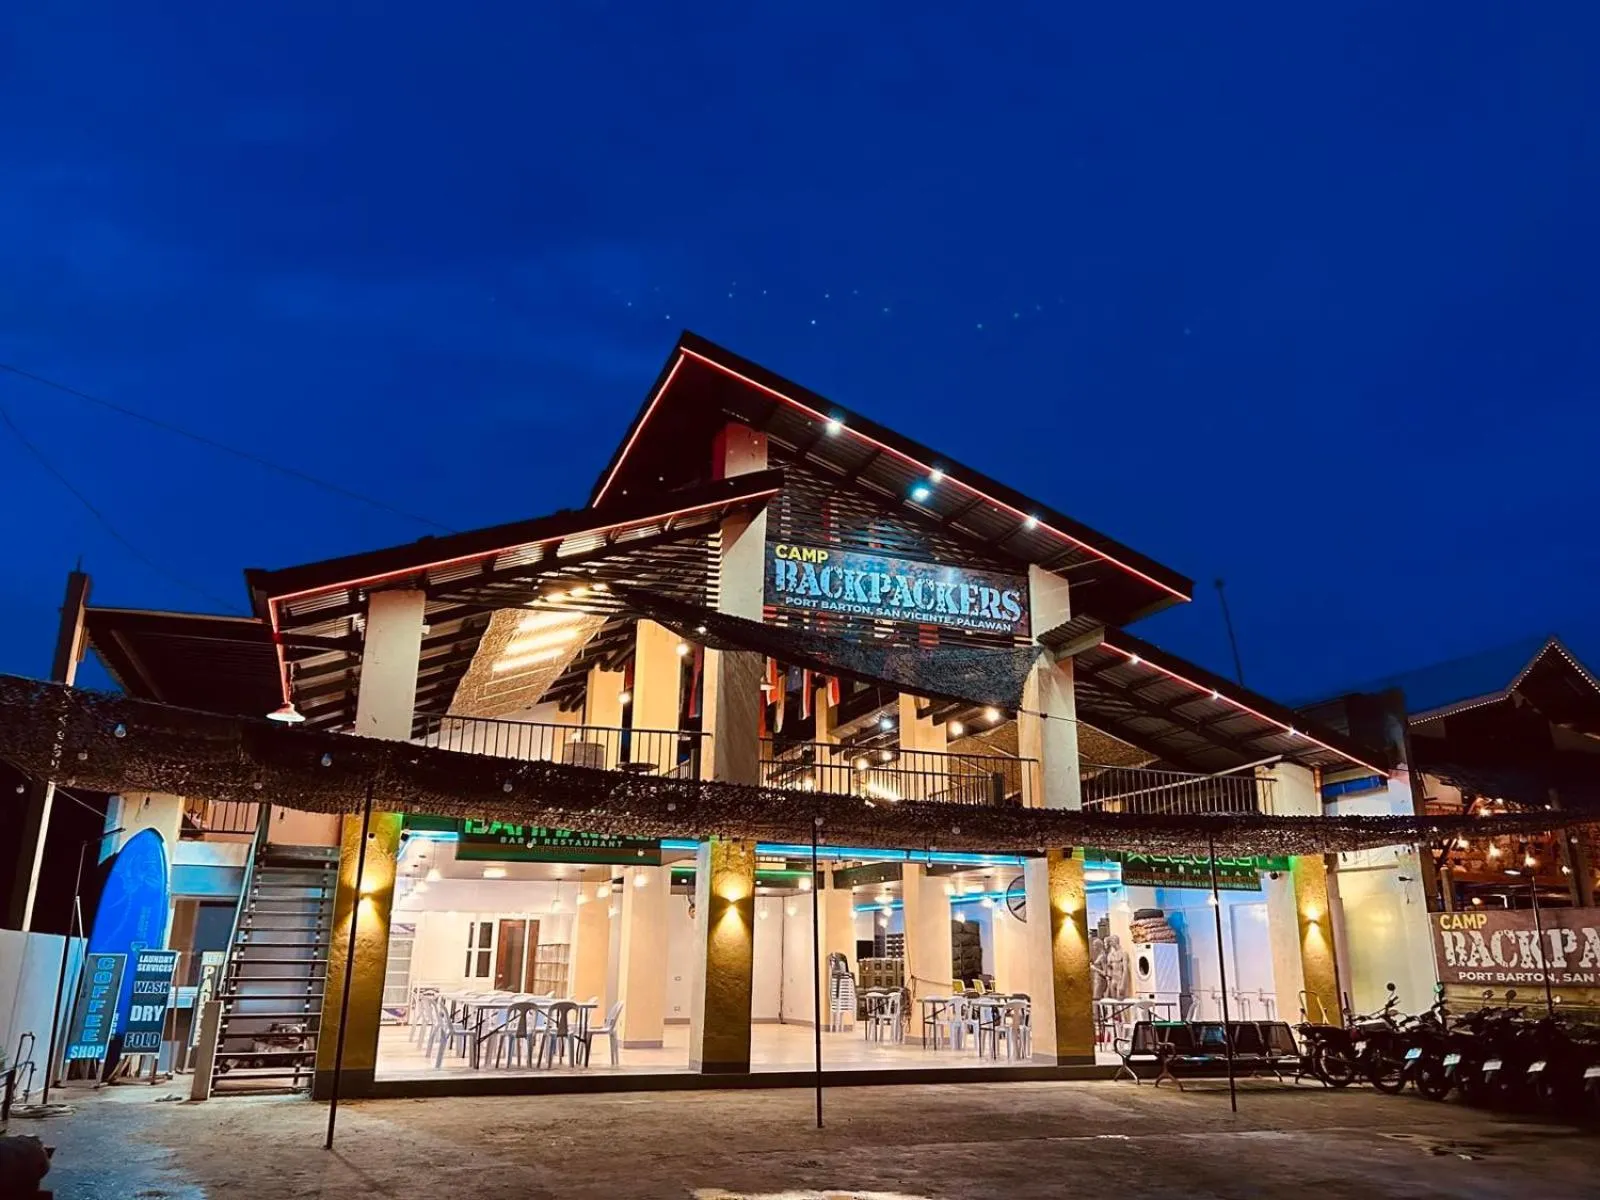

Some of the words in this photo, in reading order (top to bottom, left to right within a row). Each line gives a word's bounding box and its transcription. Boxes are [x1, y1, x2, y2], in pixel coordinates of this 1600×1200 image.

[775, 544, 829, 563] CAMP
[775, 559, 1021, 622] BACKPACKERS
[785, 597, 818, 608] PORT
[821, 600, 874, 615] BARTON,
[876, 607, 900, 618] SAN
[903, 611, 954, 625] VICENTE,
[957, 617, 1011, 632] PALAWAN
[500, 836, 524, 844] BAR
[545, 838, 622, 848] RESTAURANT
[1440, 914, 1488, 930] CAMP
[137, 963, 173, 972] SERVICES
[140, 955, 175, 964] LAUNDRY
[1459, 972, 1493, 981] PORT
[1563, 973, 1595, 983] SAN
[134, 981, 170, 993] WASH
[82, 957, 116, 1042] COFFEE
[130, 1004, 165, 1022] DRY
[124, 1032, 161, 1048] FOLD
[70, 1045, 105, 1059] SHOP
